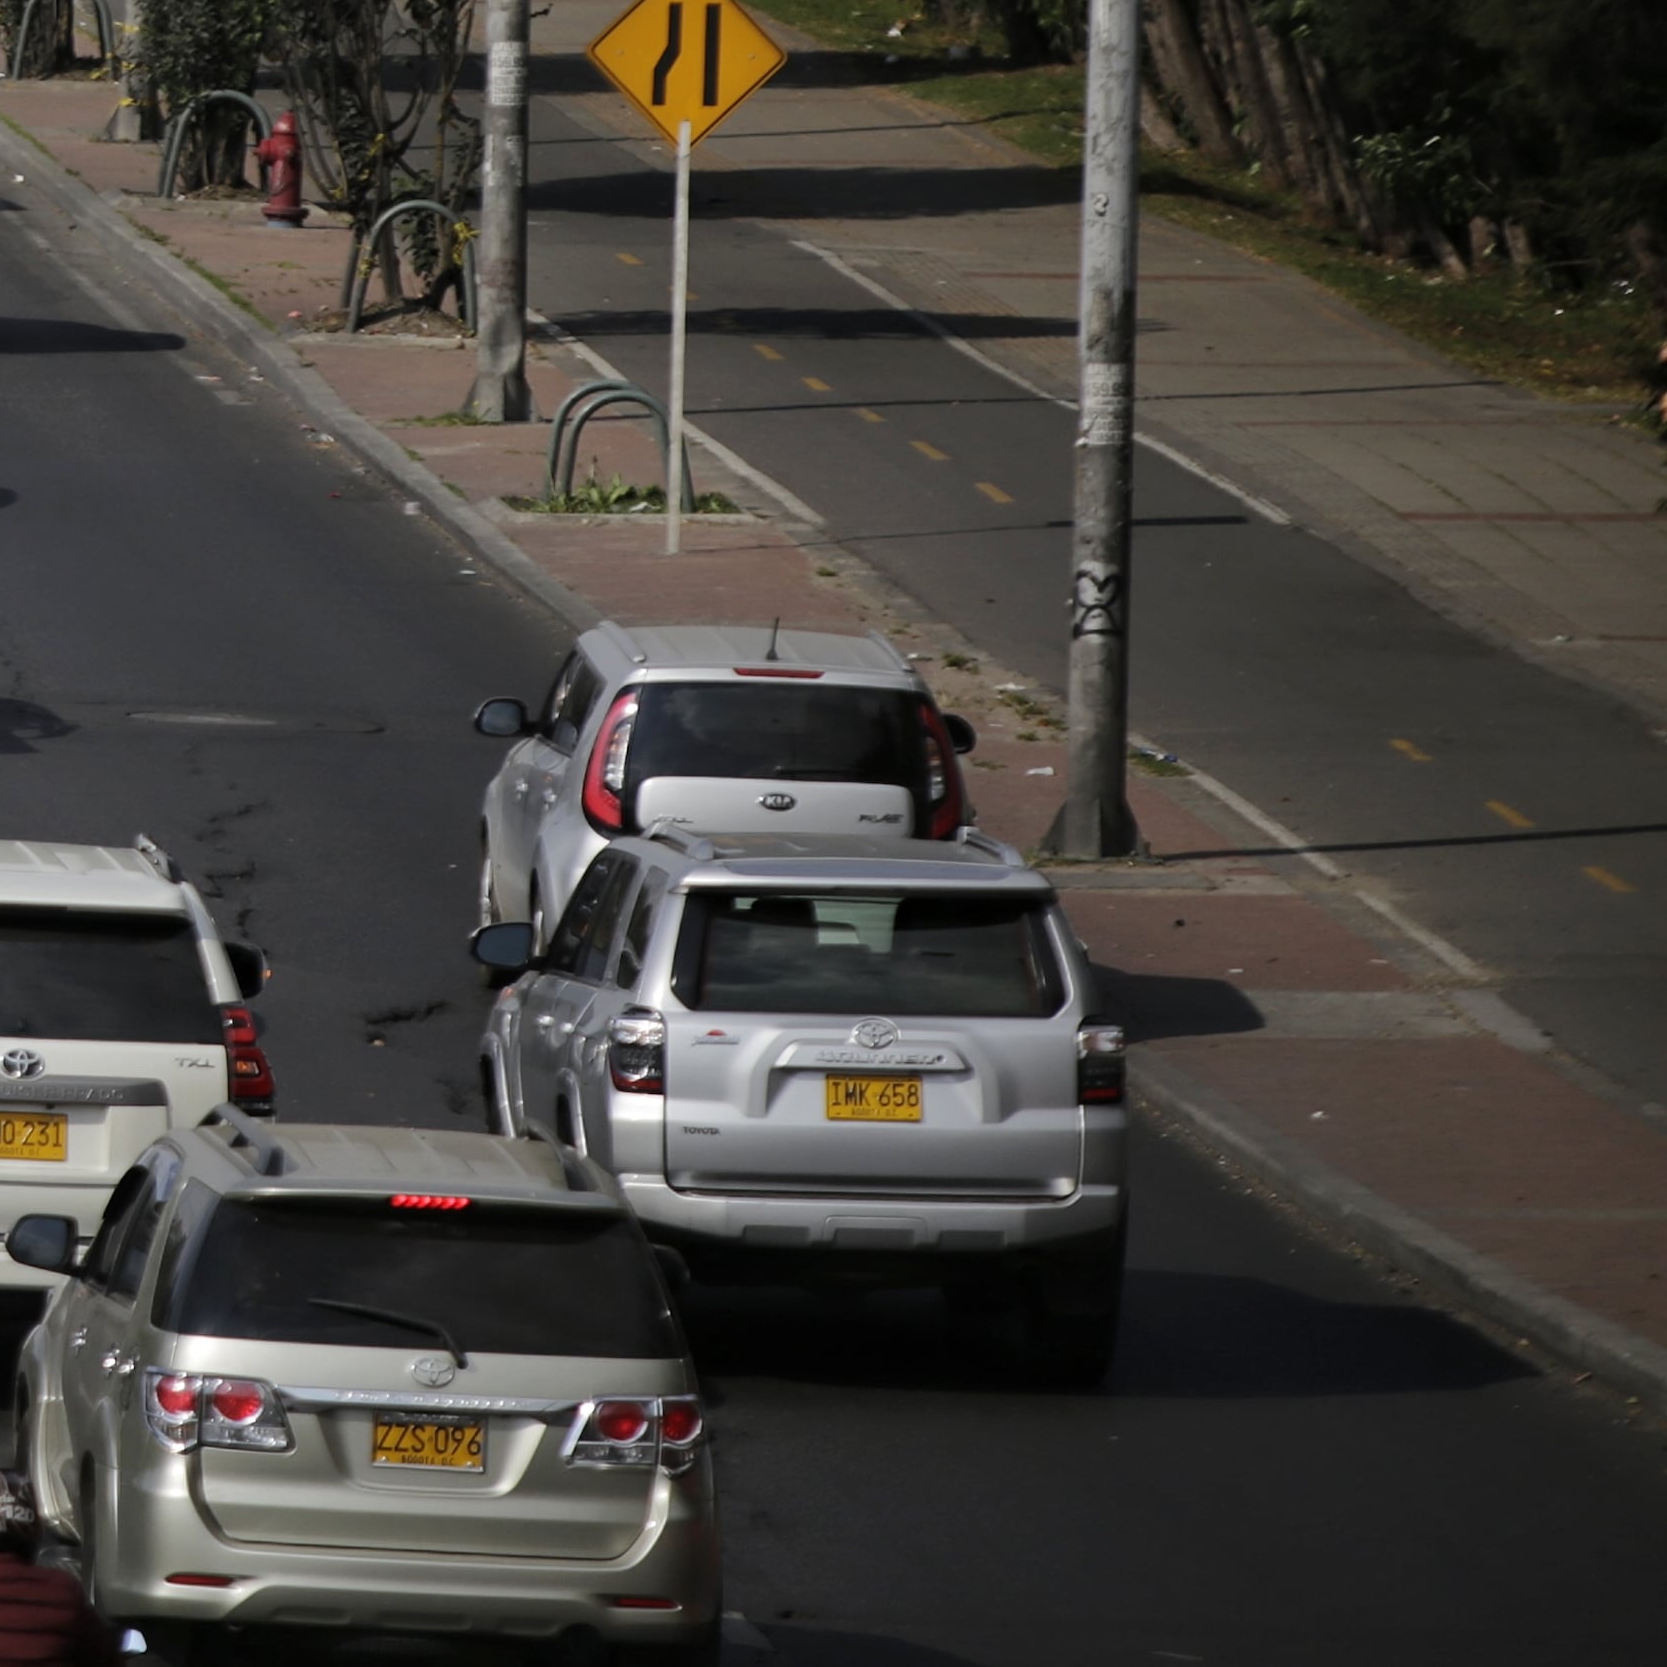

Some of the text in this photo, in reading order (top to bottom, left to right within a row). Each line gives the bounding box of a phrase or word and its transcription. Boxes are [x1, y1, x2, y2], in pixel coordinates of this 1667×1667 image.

[878, 1082, 919, 1107] 658
[682, 1126, 721, 1135] TOYOTA
[433, 1426, 482, 1456] 096
